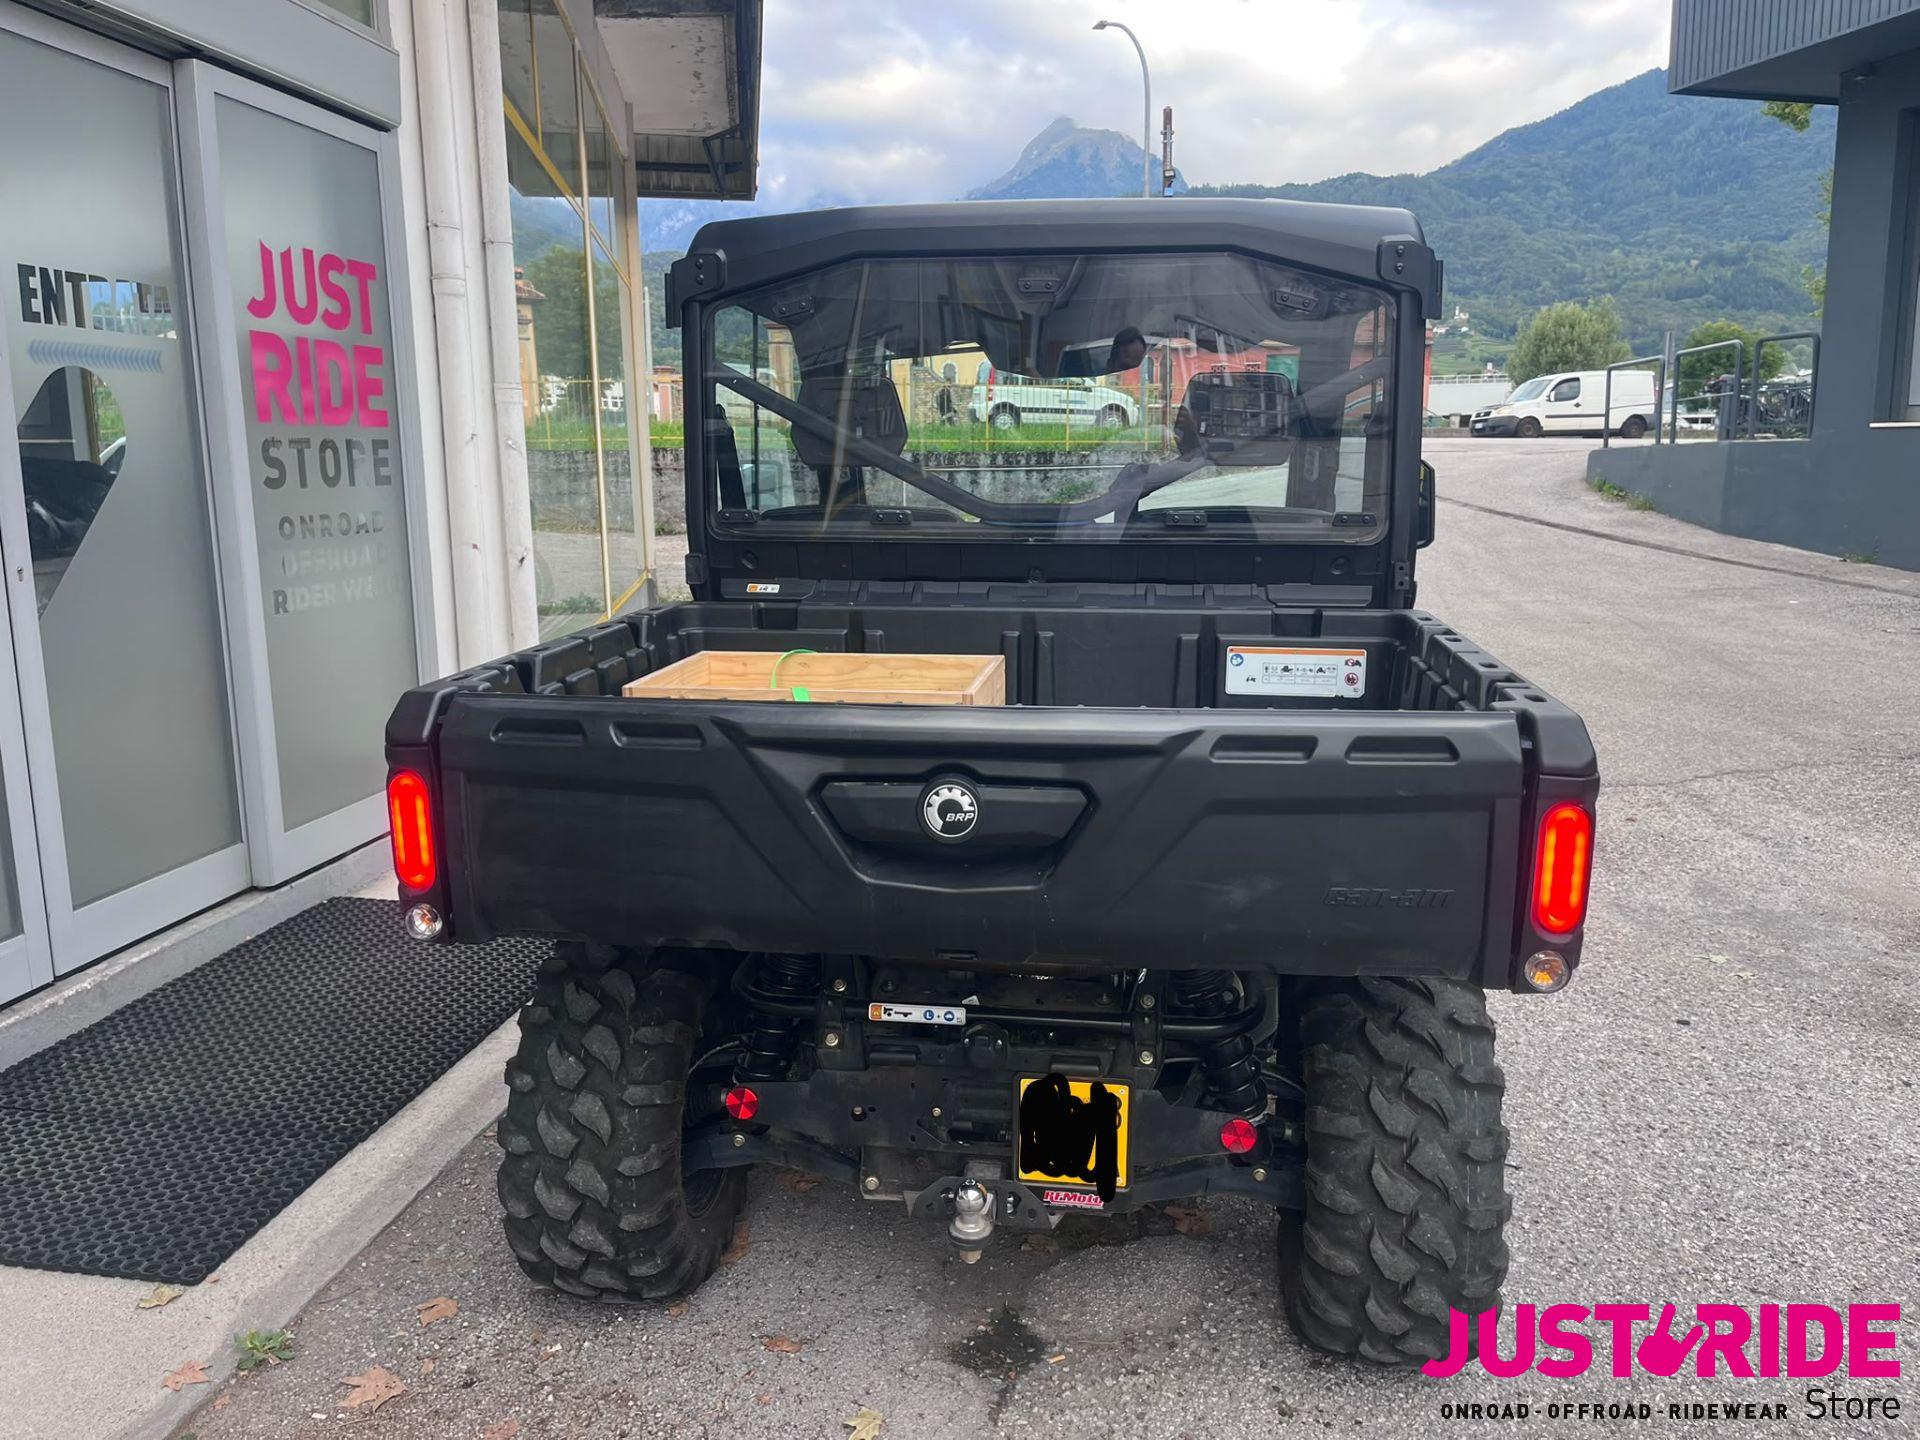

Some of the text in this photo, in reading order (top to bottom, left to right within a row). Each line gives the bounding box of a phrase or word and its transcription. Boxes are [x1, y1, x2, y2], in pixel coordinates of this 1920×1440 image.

[247, 238, 377, 335] JUST
[249, 330, 389, 428] RIDE
[261, 437, 392, 490] STORE
[278, 510, 384, 541] ONROAD
[340, 570, 401, 600] WE
[945, 812, 975, 822] BRP
